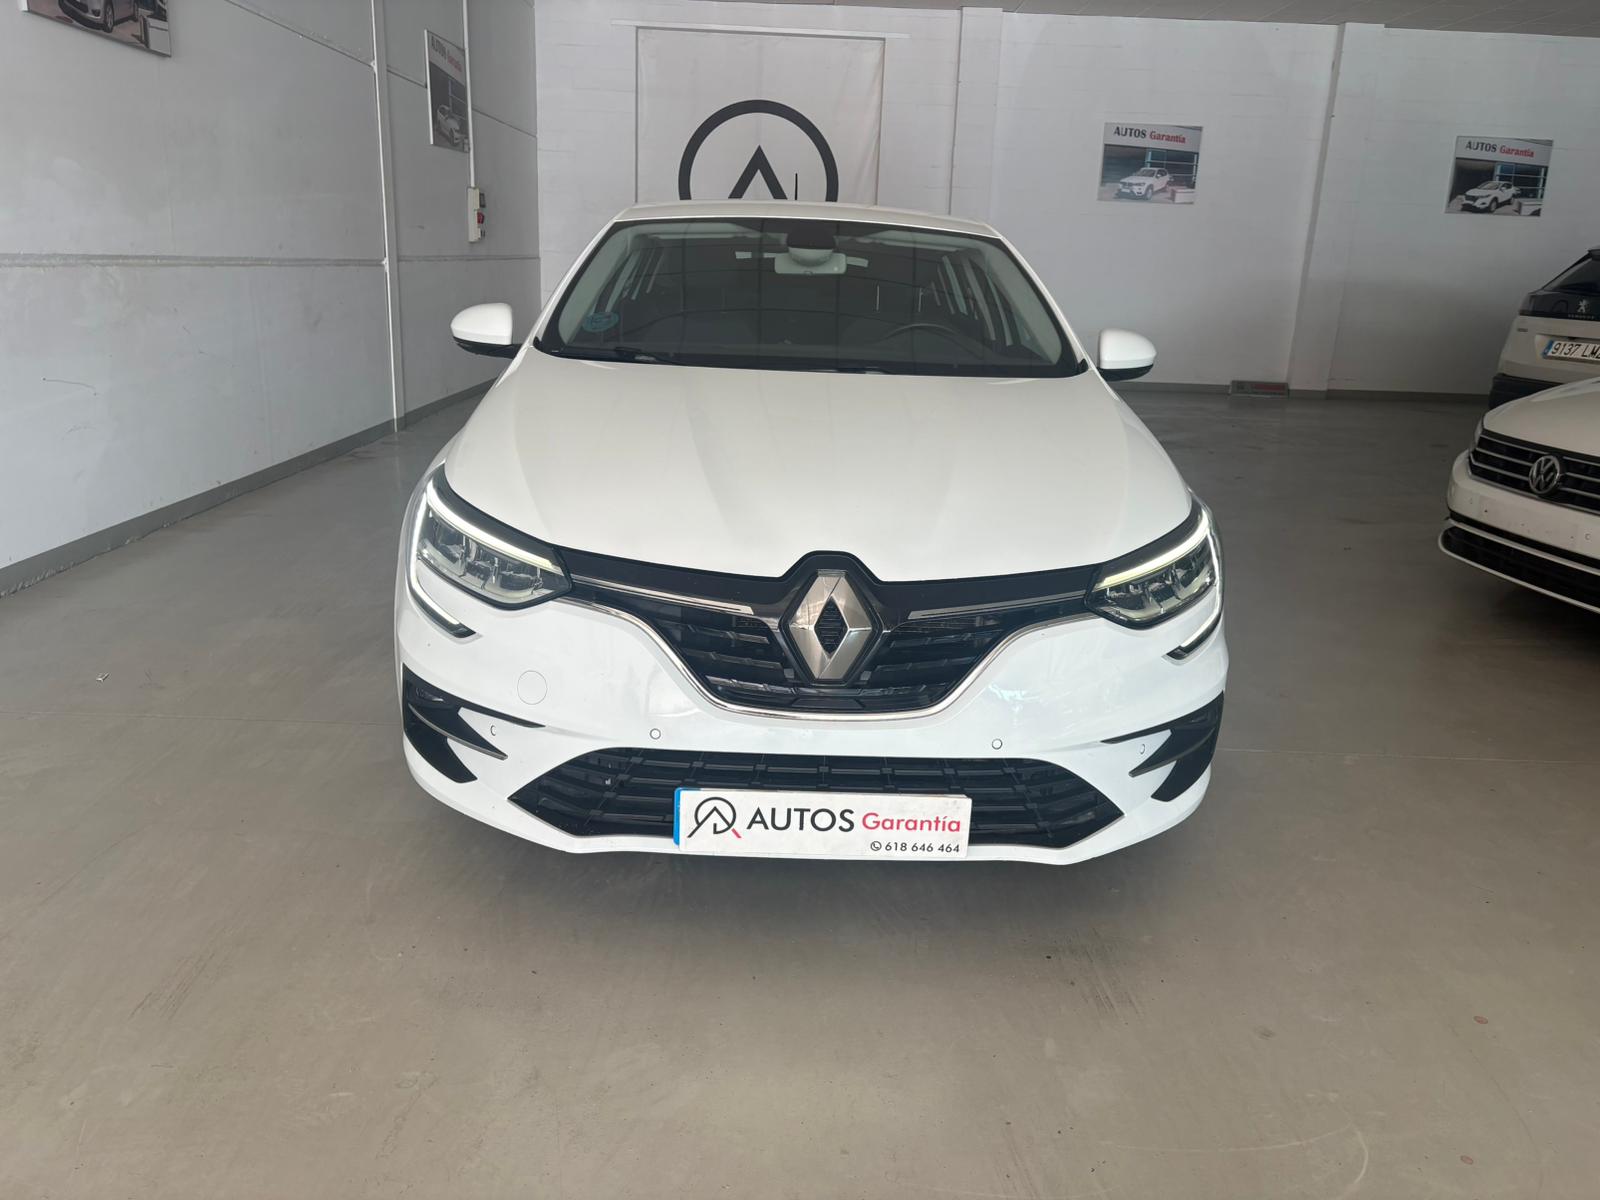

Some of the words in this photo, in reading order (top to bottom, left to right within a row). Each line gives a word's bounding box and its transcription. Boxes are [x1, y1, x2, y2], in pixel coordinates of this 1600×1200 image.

[1114, 126, 1147, 139] AUTOS
[1466, 140, 1498, 153] AUTOS
[1551, 342, 1581, 357] 9137
[746, 806, 855, 833] AUTOS
[861, 812, 961, 832] Garantía
[885, 841, 907, 852] 618
[911, 842, 934, 853] 646
[937, 843, 960, 854] 464
